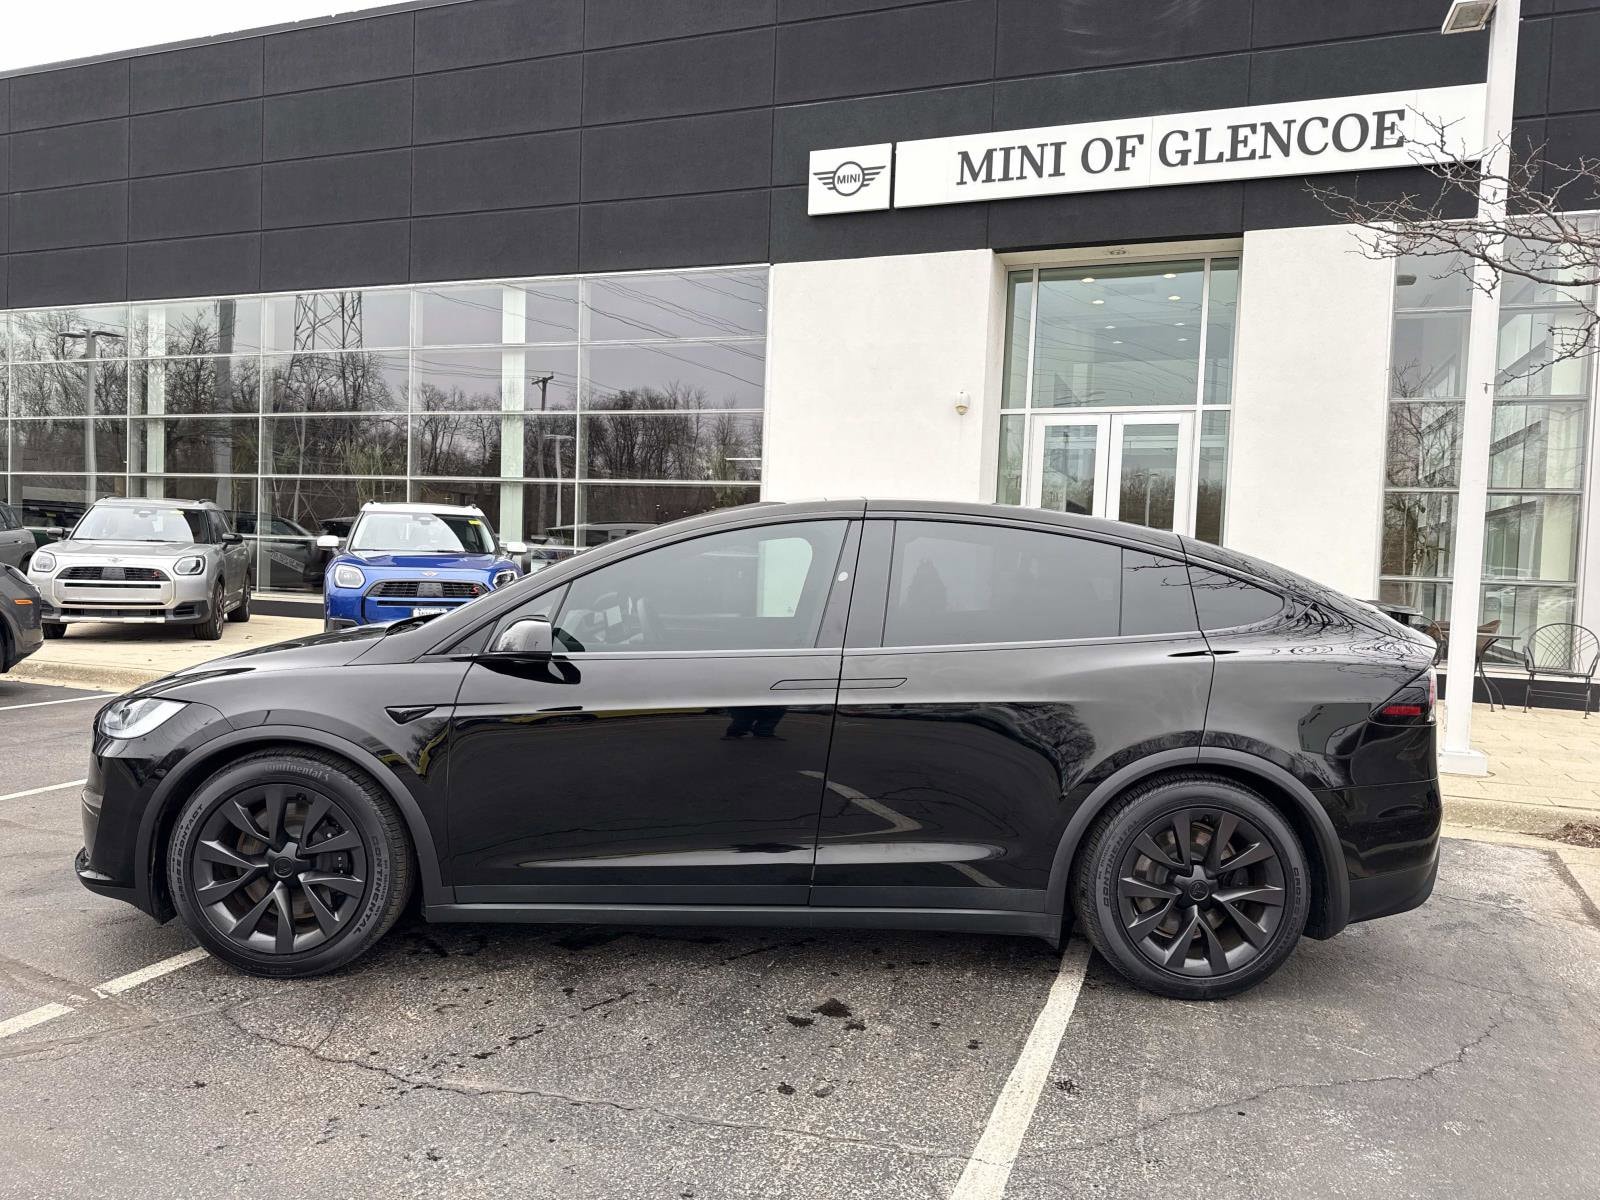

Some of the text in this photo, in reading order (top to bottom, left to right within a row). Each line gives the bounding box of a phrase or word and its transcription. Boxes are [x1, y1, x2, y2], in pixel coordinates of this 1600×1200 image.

[837, 173, 861, 185] MINI
[956, 109, 1407, 186] MINI OF GLENCOE
[353, 835, 383, 935] CONTINENTAL
